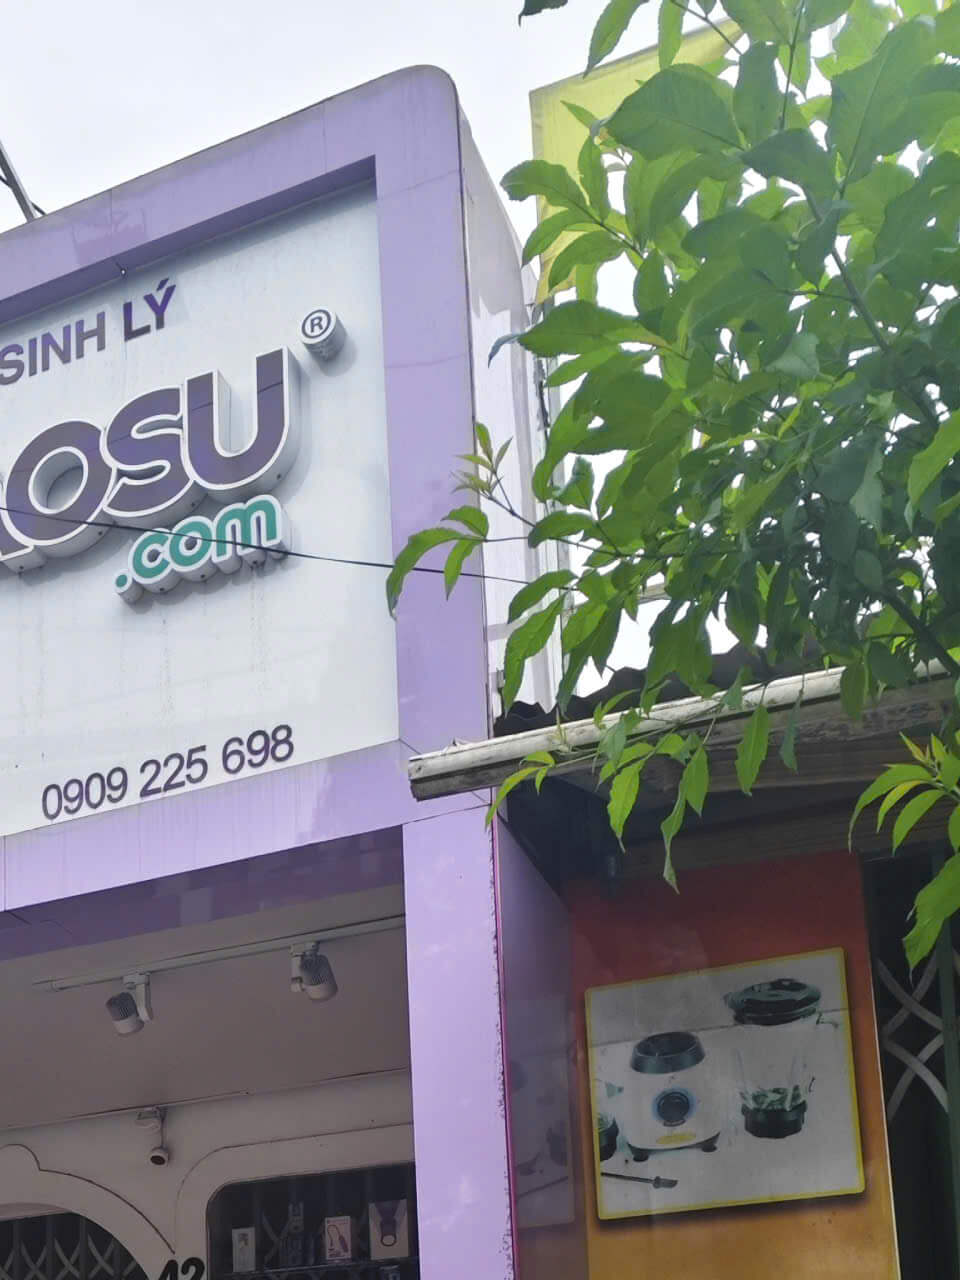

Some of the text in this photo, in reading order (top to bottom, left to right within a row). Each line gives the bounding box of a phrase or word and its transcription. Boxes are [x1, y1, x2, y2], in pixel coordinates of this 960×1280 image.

[122, 277, 177, 343] LÝ
[41, 723, 295, 821] 0909 225 698
